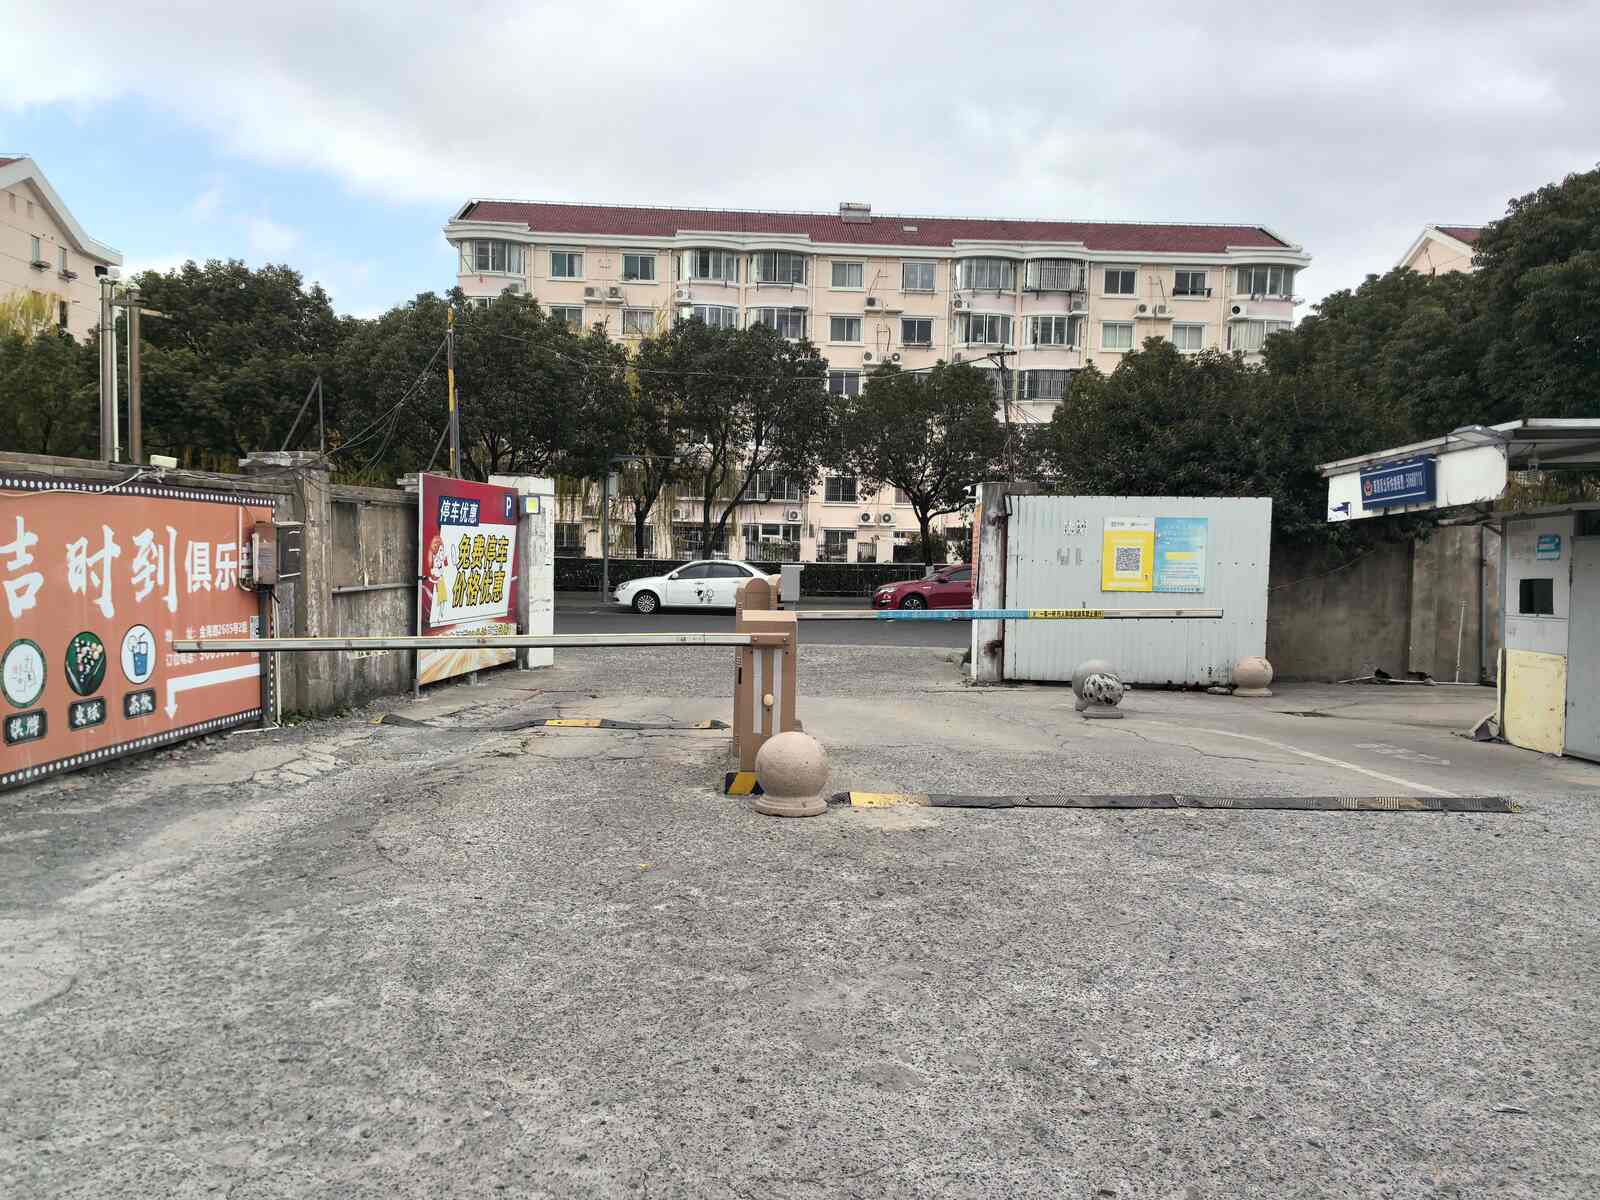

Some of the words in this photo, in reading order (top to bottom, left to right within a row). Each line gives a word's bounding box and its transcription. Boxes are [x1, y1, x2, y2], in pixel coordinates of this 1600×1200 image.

[440, 499, 479, 524] 停车优惠
[505, 496, 512, 518] P
[456, 533, 509, 570] 免费停车
[452, 570, 506, 608] 价格优惠
